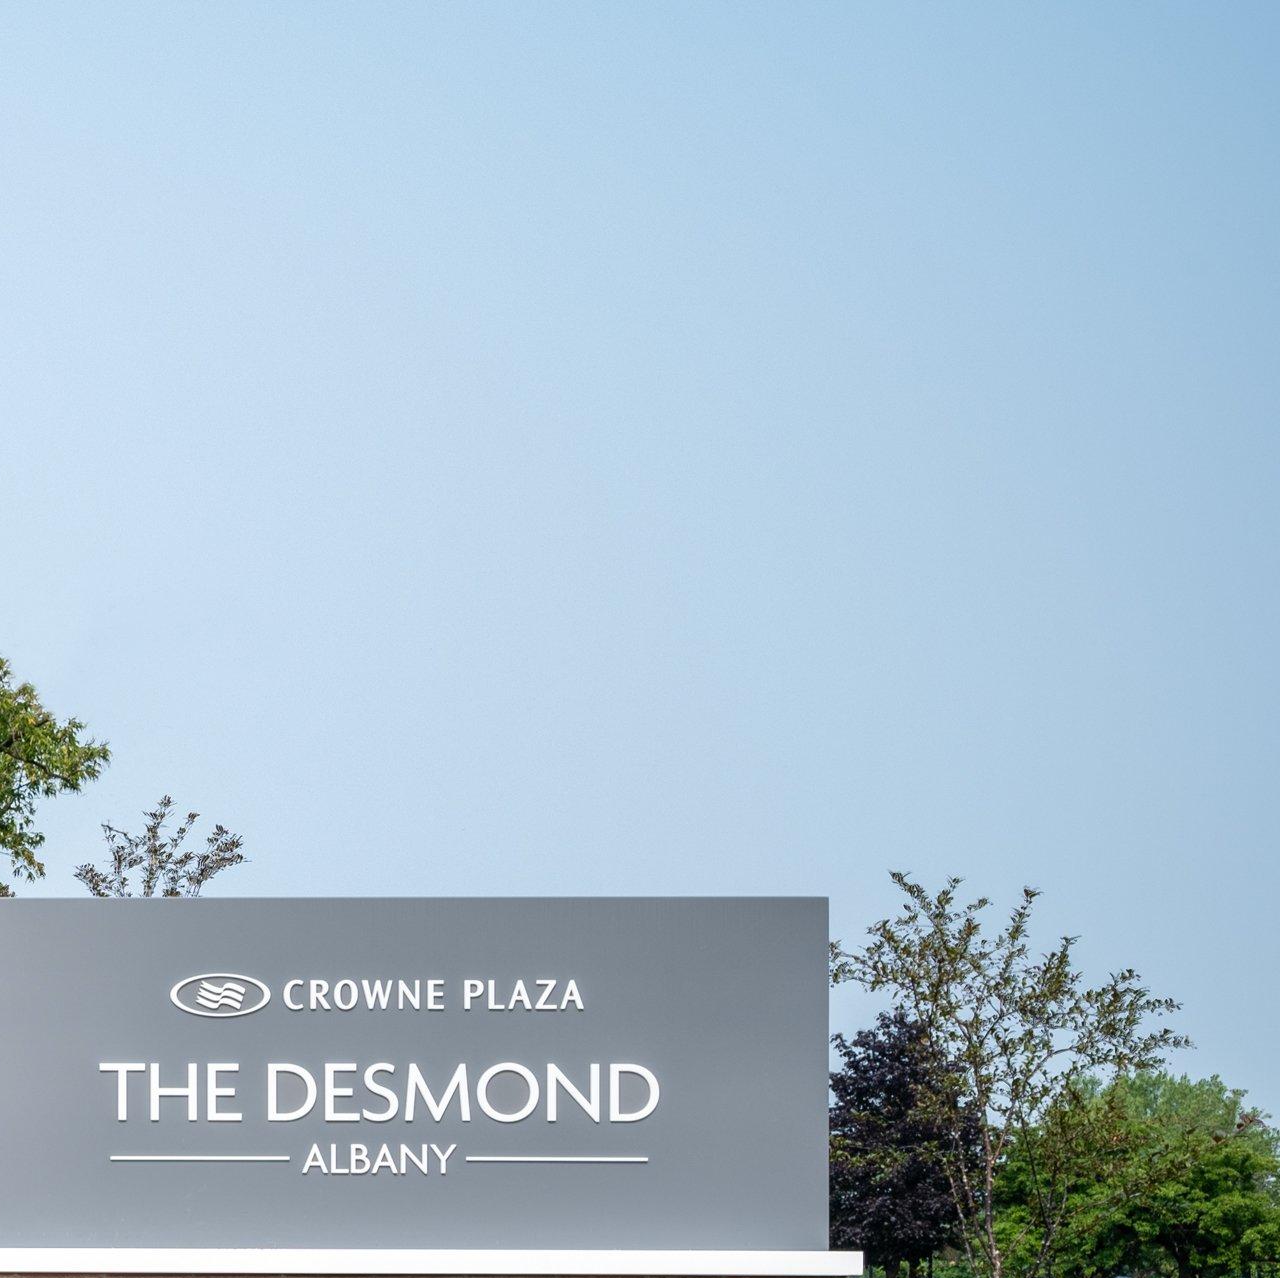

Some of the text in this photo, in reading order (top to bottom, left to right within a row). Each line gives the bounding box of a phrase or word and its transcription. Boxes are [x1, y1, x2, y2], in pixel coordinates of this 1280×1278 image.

[282, 978, 586, 1011] CROWNE PLAZA
[98, 1061, 661, 1123] THE DESMOND
[301, 1143, 458, 1175] ALBANY
